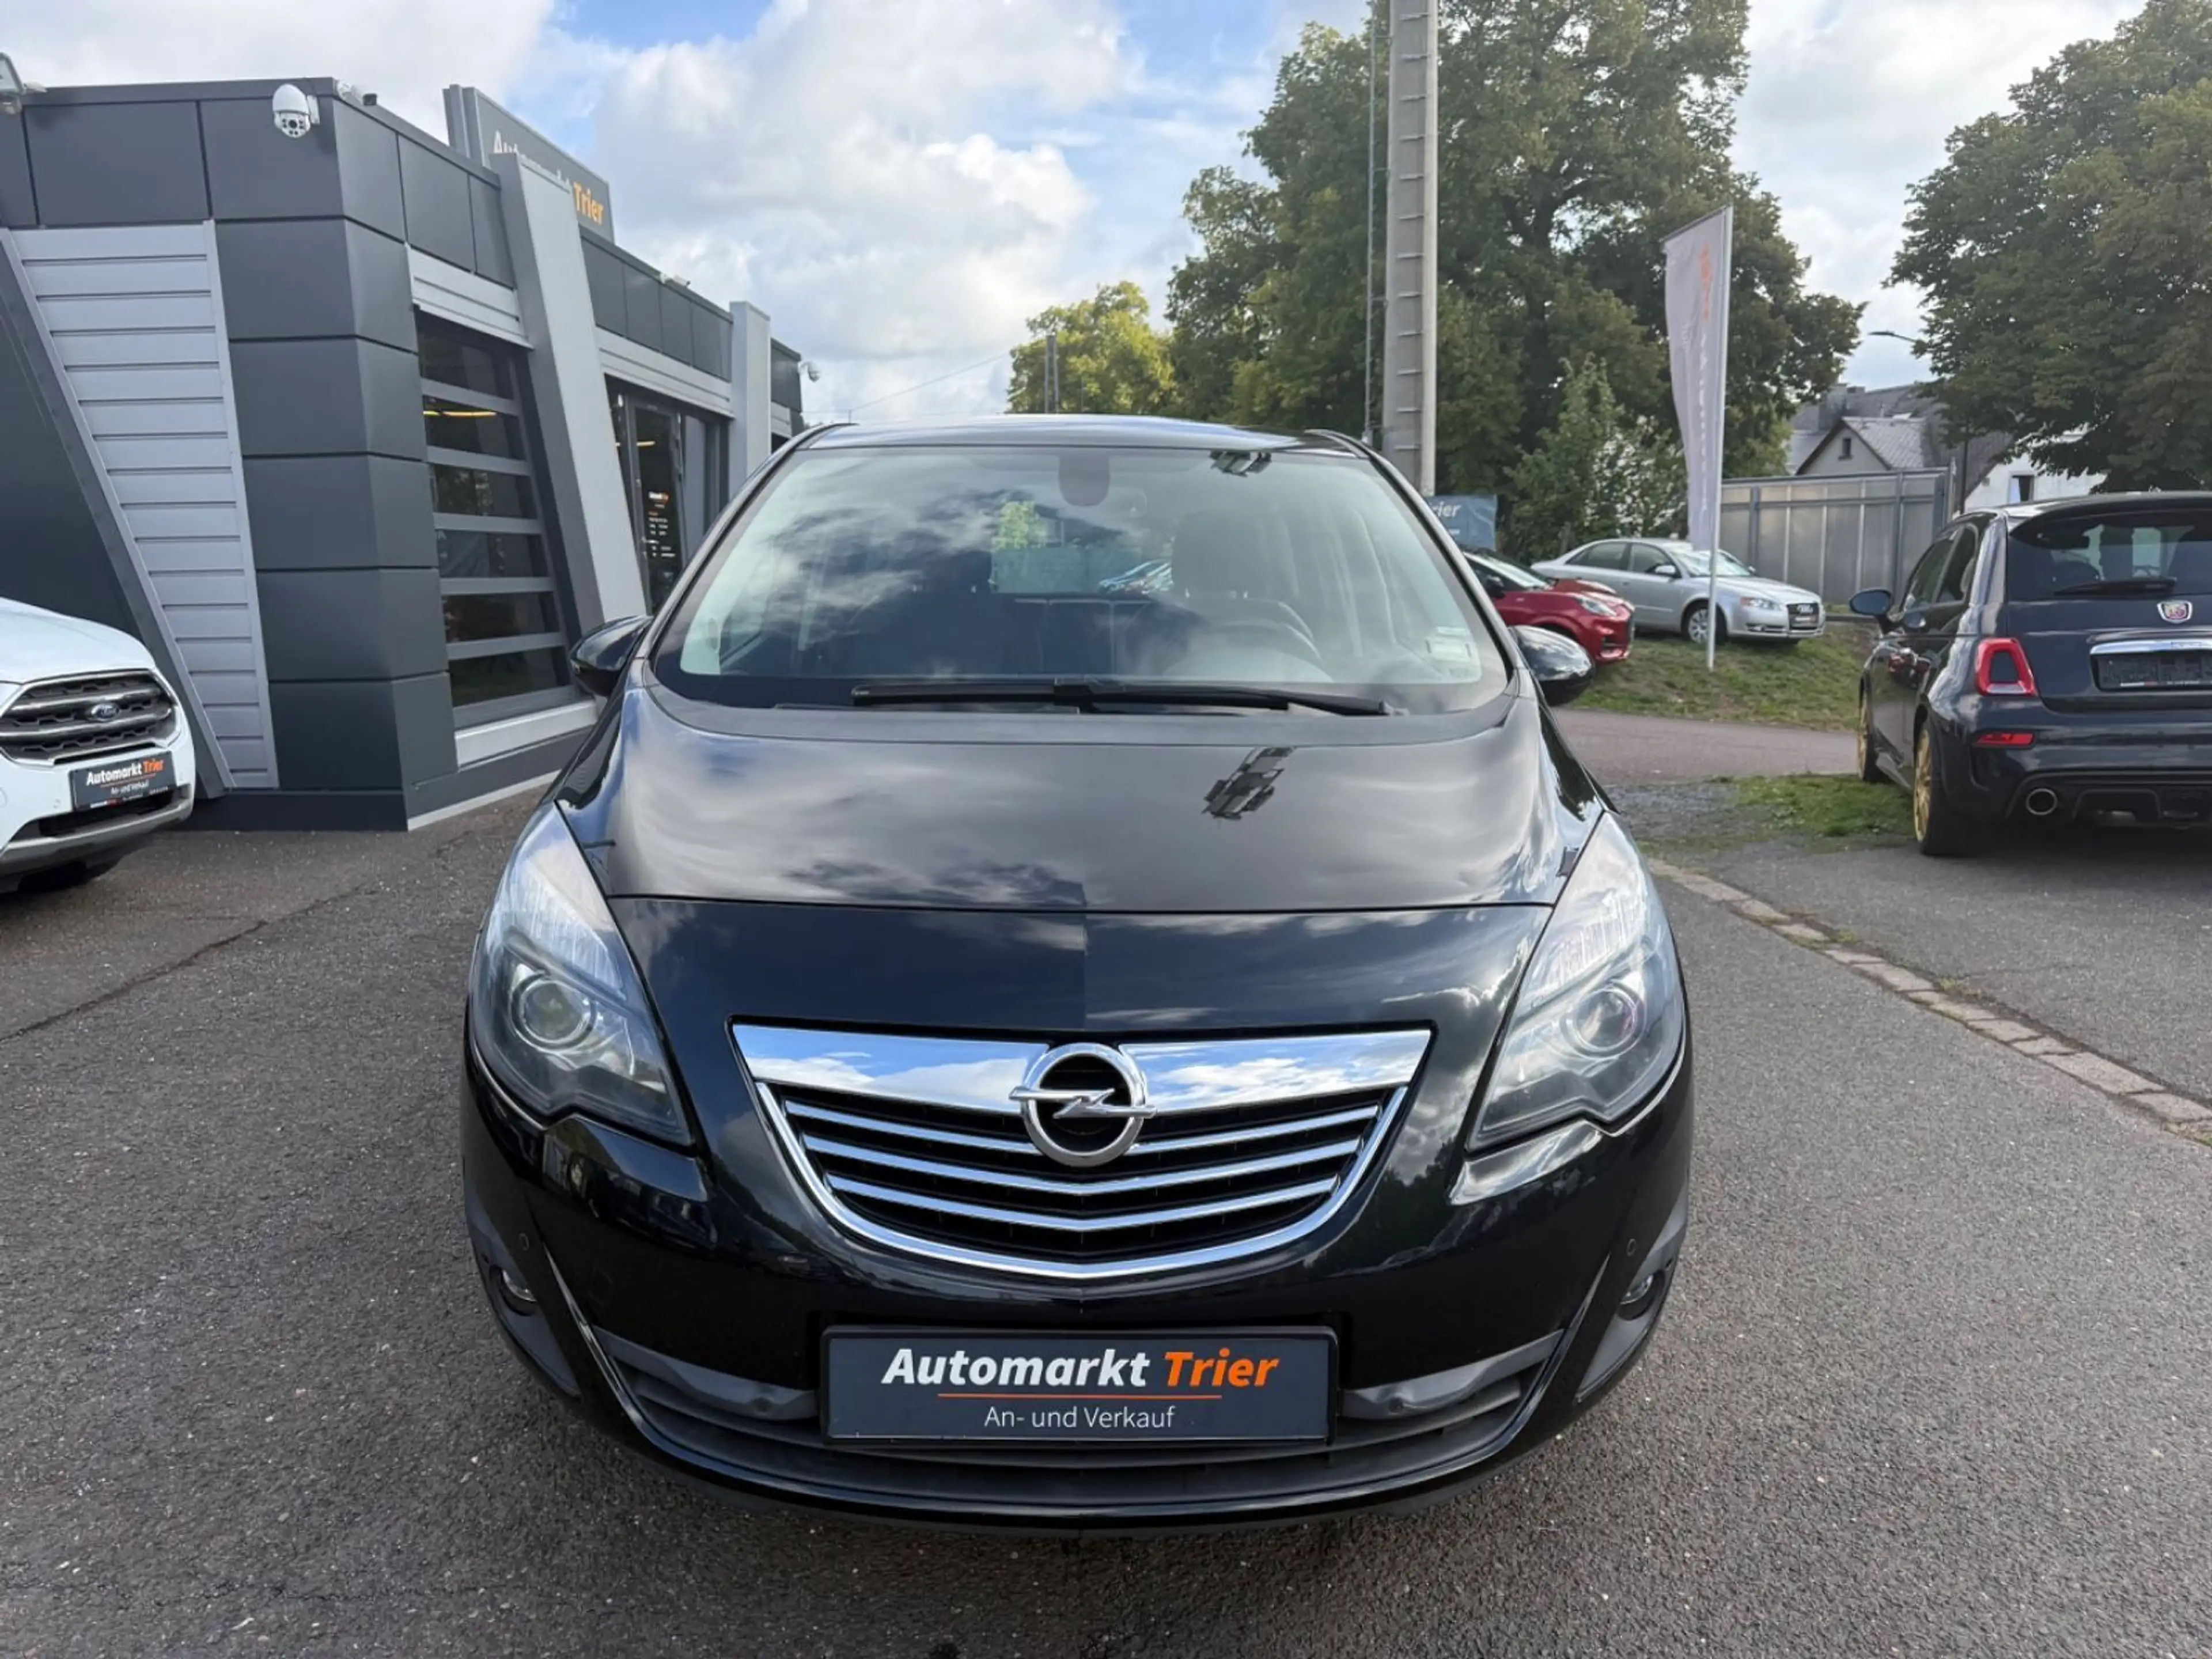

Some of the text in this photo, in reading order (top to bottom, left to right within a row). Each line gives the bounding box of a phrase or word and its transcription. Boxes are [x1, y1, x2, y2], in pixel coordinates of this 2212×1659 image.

[574, 181, 604, 225] Trier
[86, 757, 164, 786] Automarkt Trier
[881, 1348, 1280, 1387] Automarkt Trier
[984, 1406, 1176, 1428] An- und Verkauf
